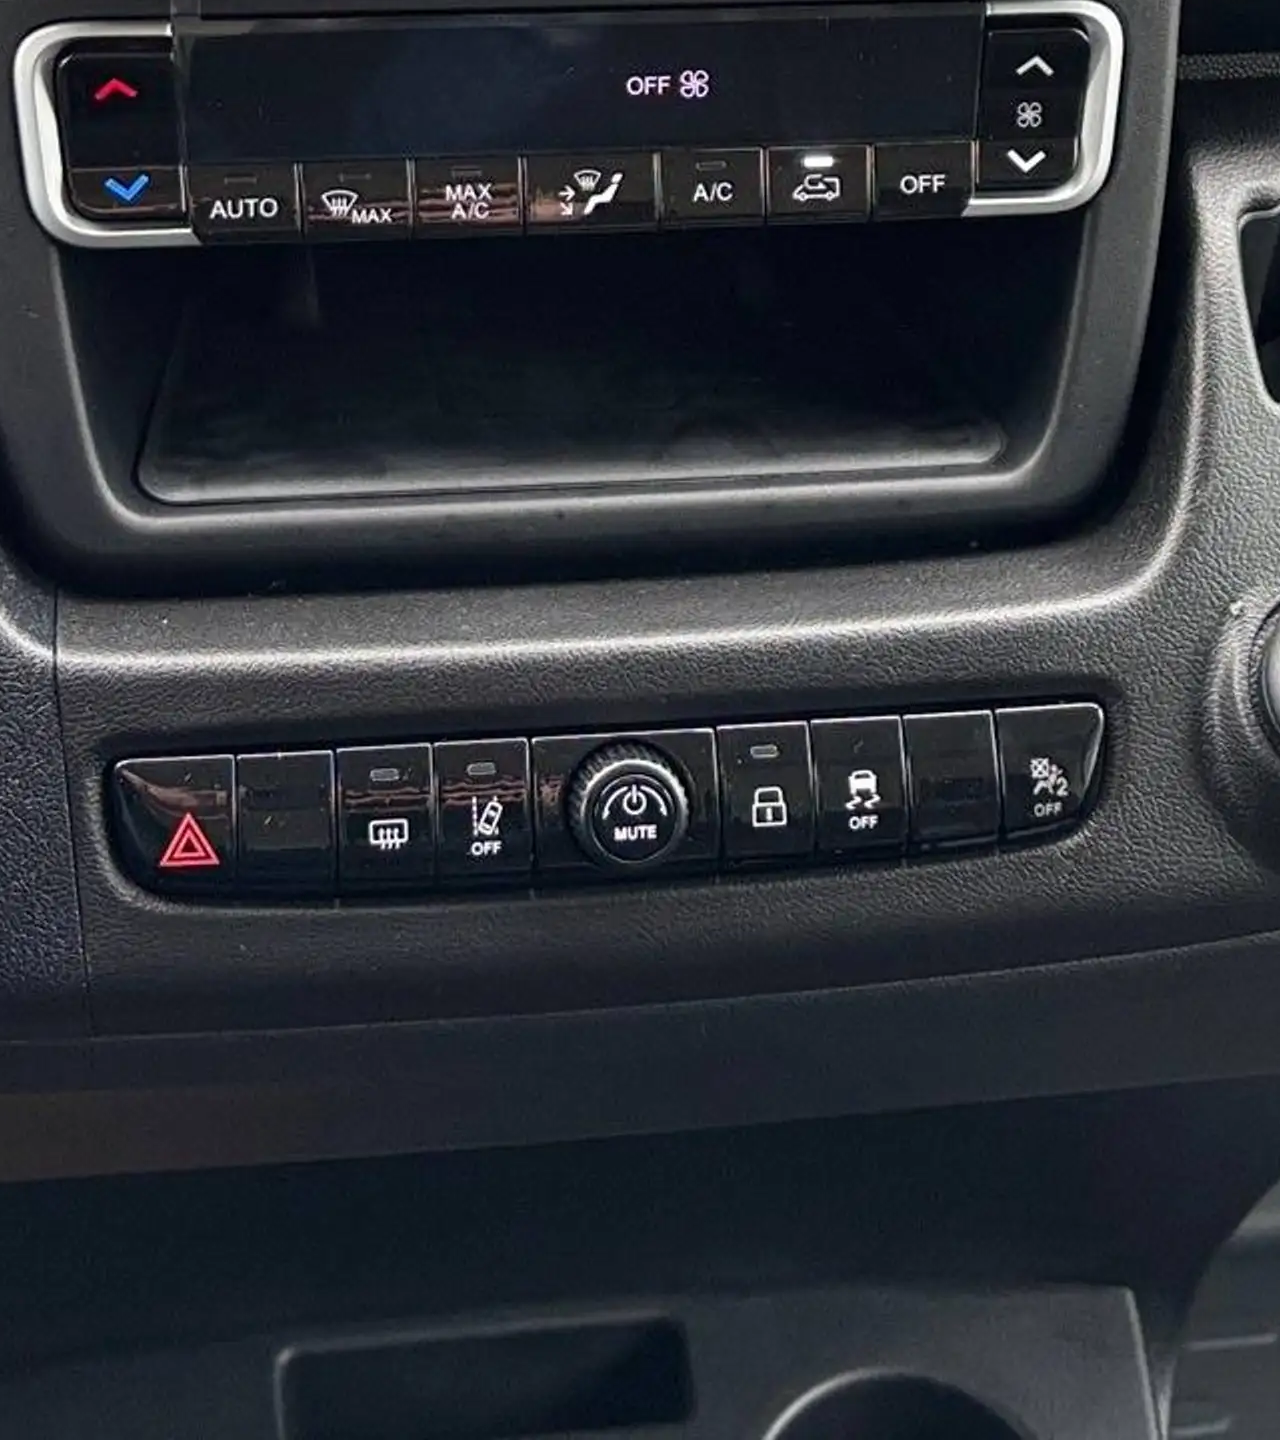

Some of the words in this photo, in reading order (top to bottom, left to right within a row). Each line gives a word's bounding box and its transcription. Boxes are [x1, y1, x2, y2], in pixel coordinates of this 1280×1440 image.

[627, 76, 670, 95] OFF
[445, 184, 491, 200] MAX
[900, 175, 945, 193] OFF
[693, 183, 732, 202] A/C
[210, 198, 277, 218] AUTO
[352, 208, 392, 223] MAX
[452, 202, 488, 220] A/C
[1034, 802, 1062, 817] OFF
[849, 816, 877, 830] OFF
[615, 825, 657, 840] MUTE
[472, 842, 501, 855] OFF
